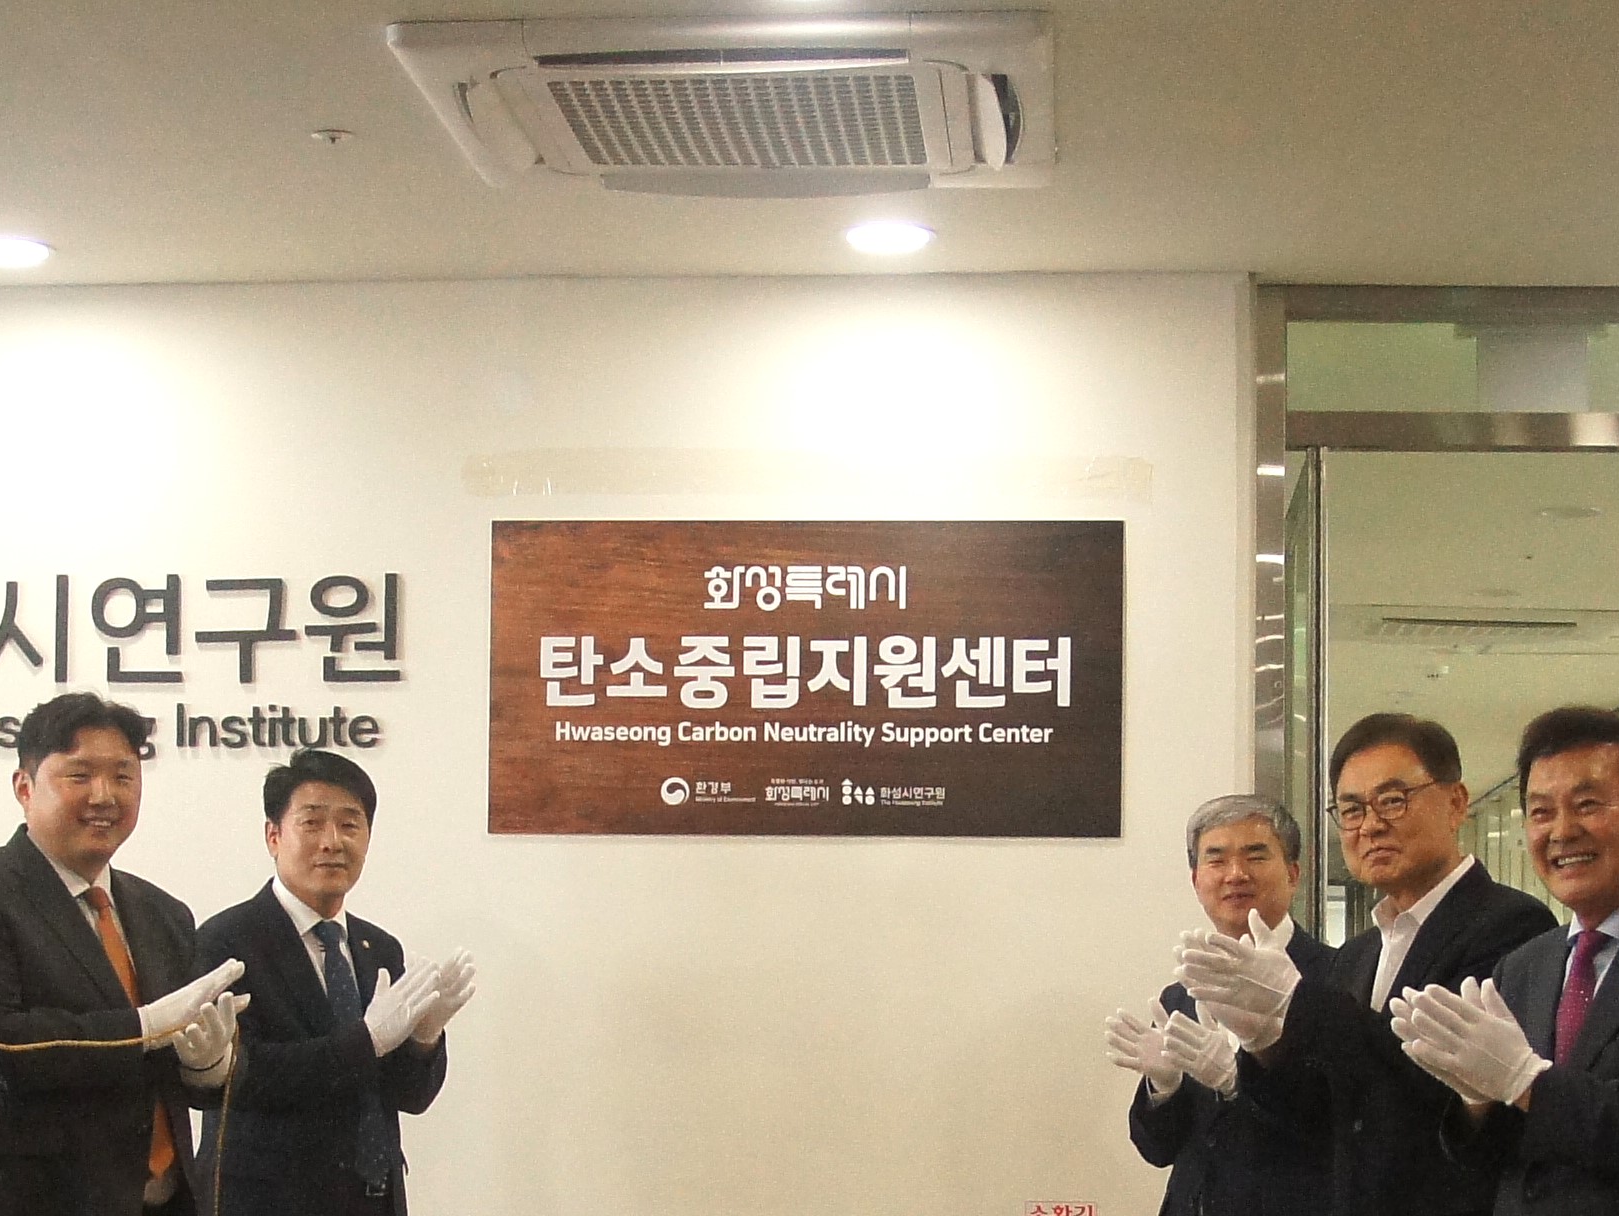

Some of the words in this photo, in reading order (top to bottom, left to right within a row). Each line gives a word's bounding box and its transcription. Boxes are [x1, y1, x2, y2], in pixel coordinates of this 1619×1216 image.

[538, 635, 1073, 711] 탄소중립지원센터
[176, 702, 381, 749] Institute
[555, 720, 672, 747] Hwaseong
[677, 721, 757, 742] Carbon
[763, 721, 876, 748] Neutrality
[881, 722, 973, 748] Support
[979, 722, 1054, 743] Center
